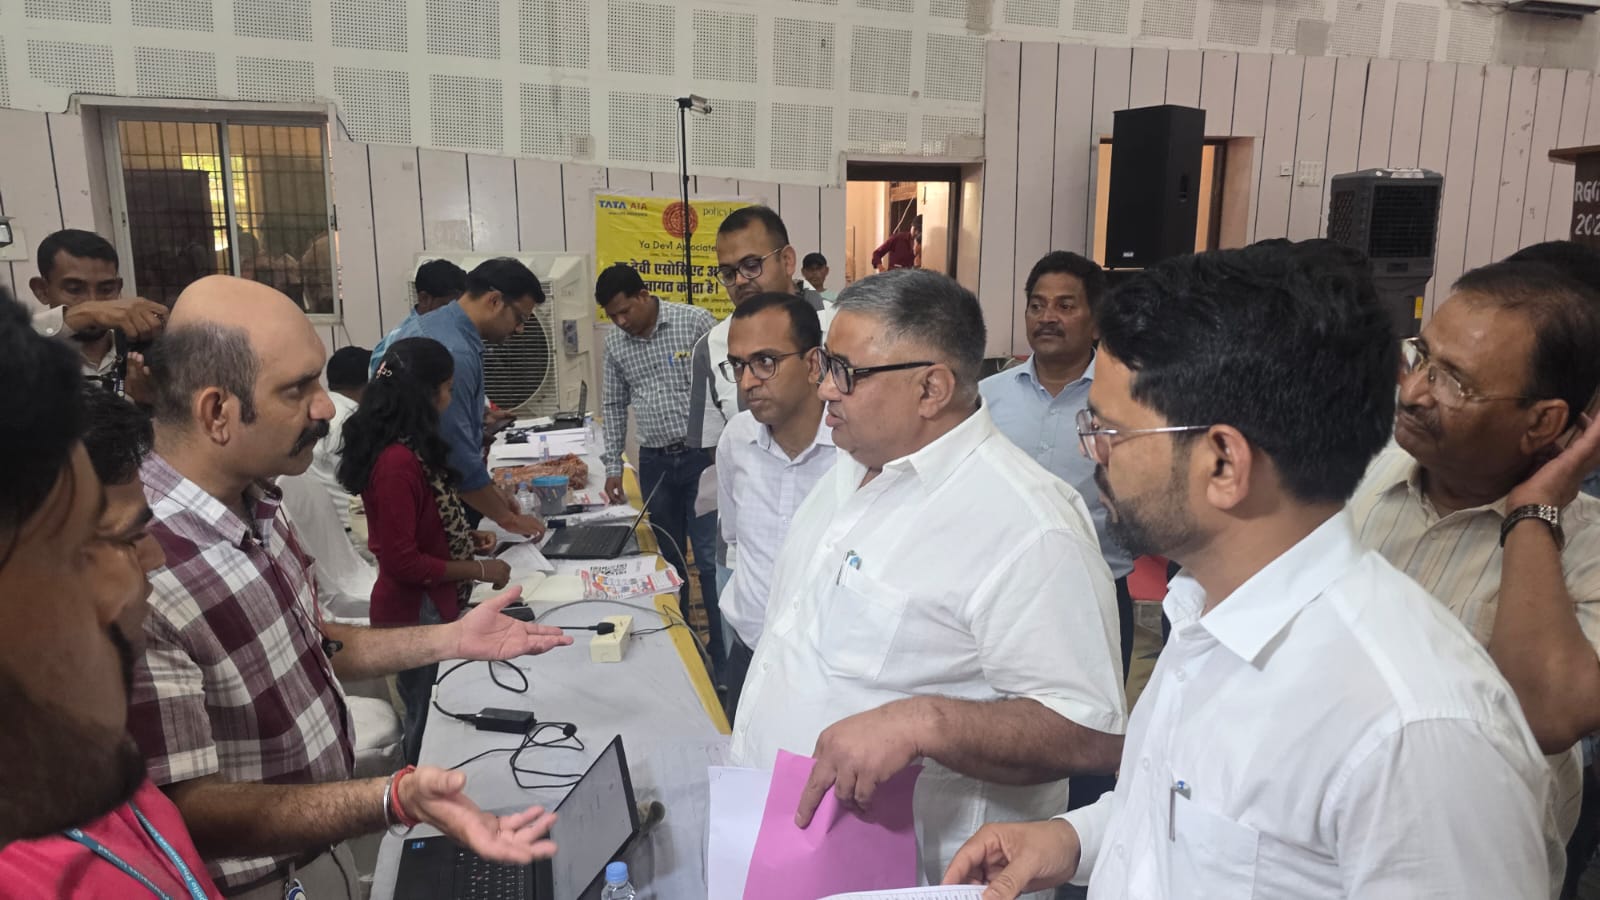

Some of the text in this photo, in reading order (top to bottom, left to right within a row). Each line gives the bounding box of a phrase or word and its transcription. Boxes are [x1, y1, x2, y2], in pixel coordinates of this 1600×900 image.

[598, 200, 648, 210] TATA AIA
[639, 240, 717, 252] Ya Devi Aociate
[643, 280, 673, 293] वागत
[676, 282, 703, 294] कता
